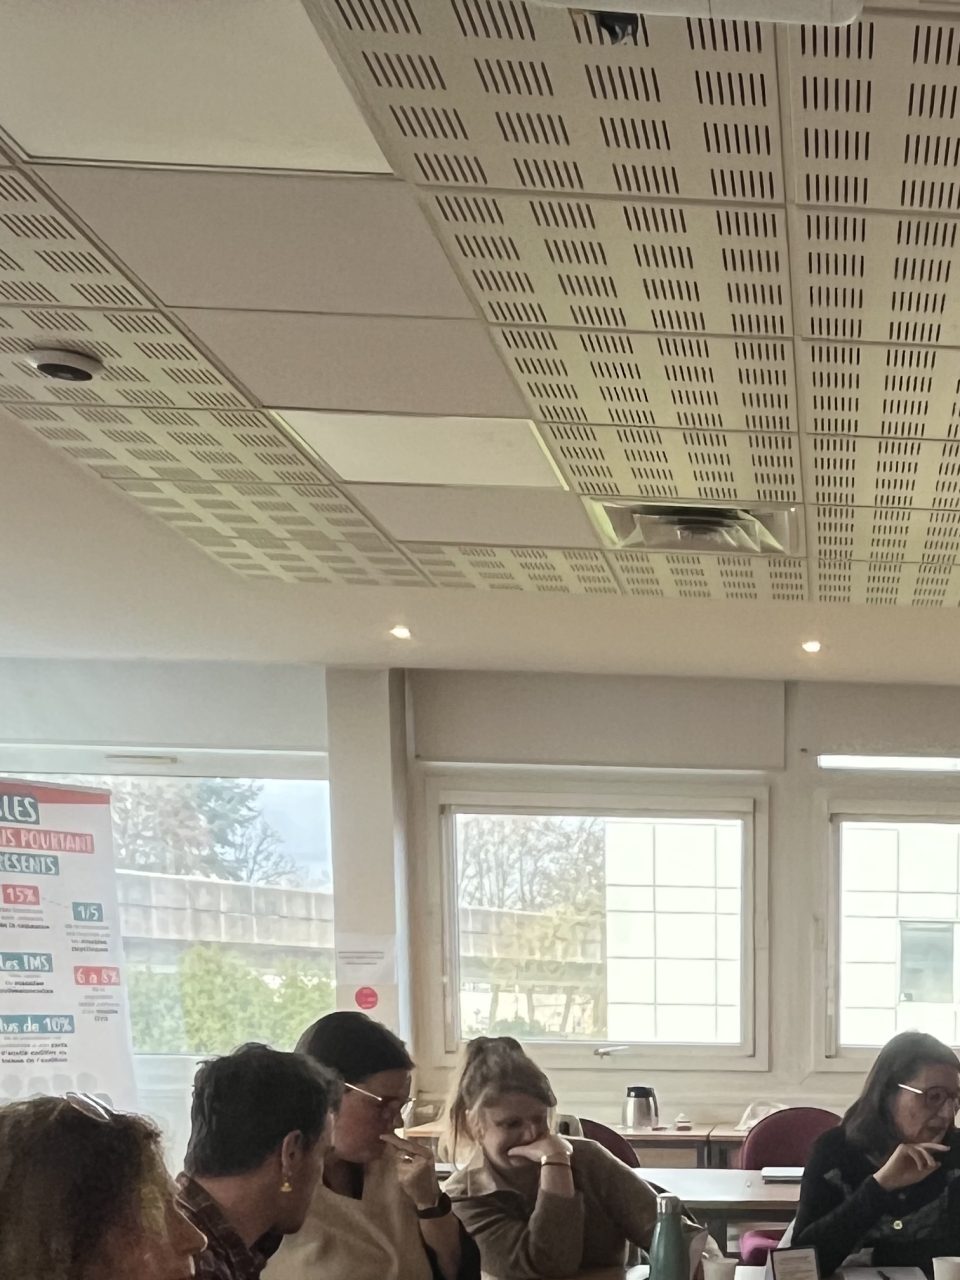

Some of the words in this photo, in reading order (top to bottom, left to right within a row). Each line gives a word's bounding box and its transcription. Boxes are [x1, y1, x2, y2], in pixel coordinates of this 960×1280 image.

[0, 794, 37, 823] LES
[20, 830, 93, 852] POURTANT
[6, 886, 36, 904] 15%
[77, 905, 100, 921] 1/5
[43, 1016, 73, 1033] 10%
